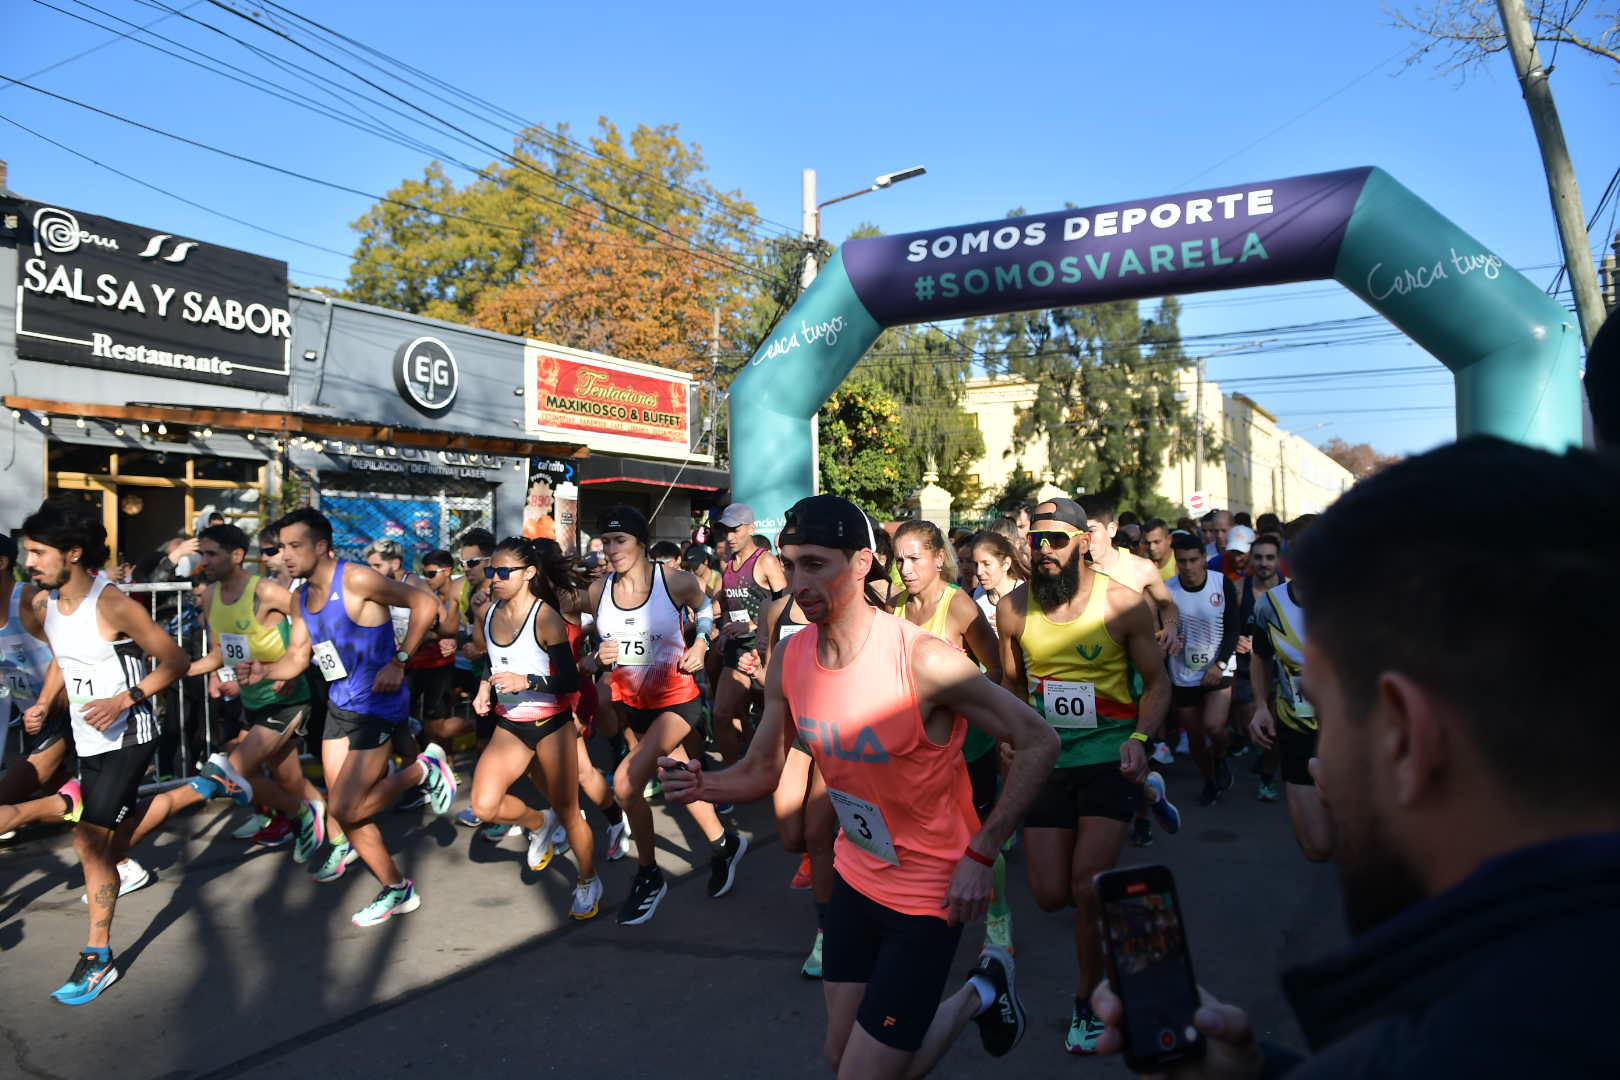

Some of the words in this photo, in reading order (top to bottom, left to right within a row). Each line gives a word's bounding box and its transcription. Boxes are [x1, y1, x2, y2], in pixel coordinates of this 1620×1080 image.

[907, 222, 1047, 263] SOMOS
[1063, 188, 1276, 243] DEPORTE
[914, 232, 1270, 301] #SOMOSVARELA
[1367, 261, 1448, 300] Cerca
[24, 258, 146, 314] SALSA
[151, 284, 176, 317] Y
[183, 291, 291, 338] SABOR
[92, 332, 233, 376] Restaurante
[575, 367, 657, 408] Tentaciones
[546, 395, 627, 419] MAXIKIOSCO
[630, 409, 638, 420] &
[643, 411, 681, 426] BUFFET
[226, 644, 244, 659] 98
[320, 654, 336, 670] 68
[620, 641, 645, 656] 75
[1191, 653, 1209, 664] 65
[73, 678, 94, 696] 71
[1055, 697, 1085, 717] 60
[799, 716, 890, 764] FILA
[853, 813, 873, 840] 3
